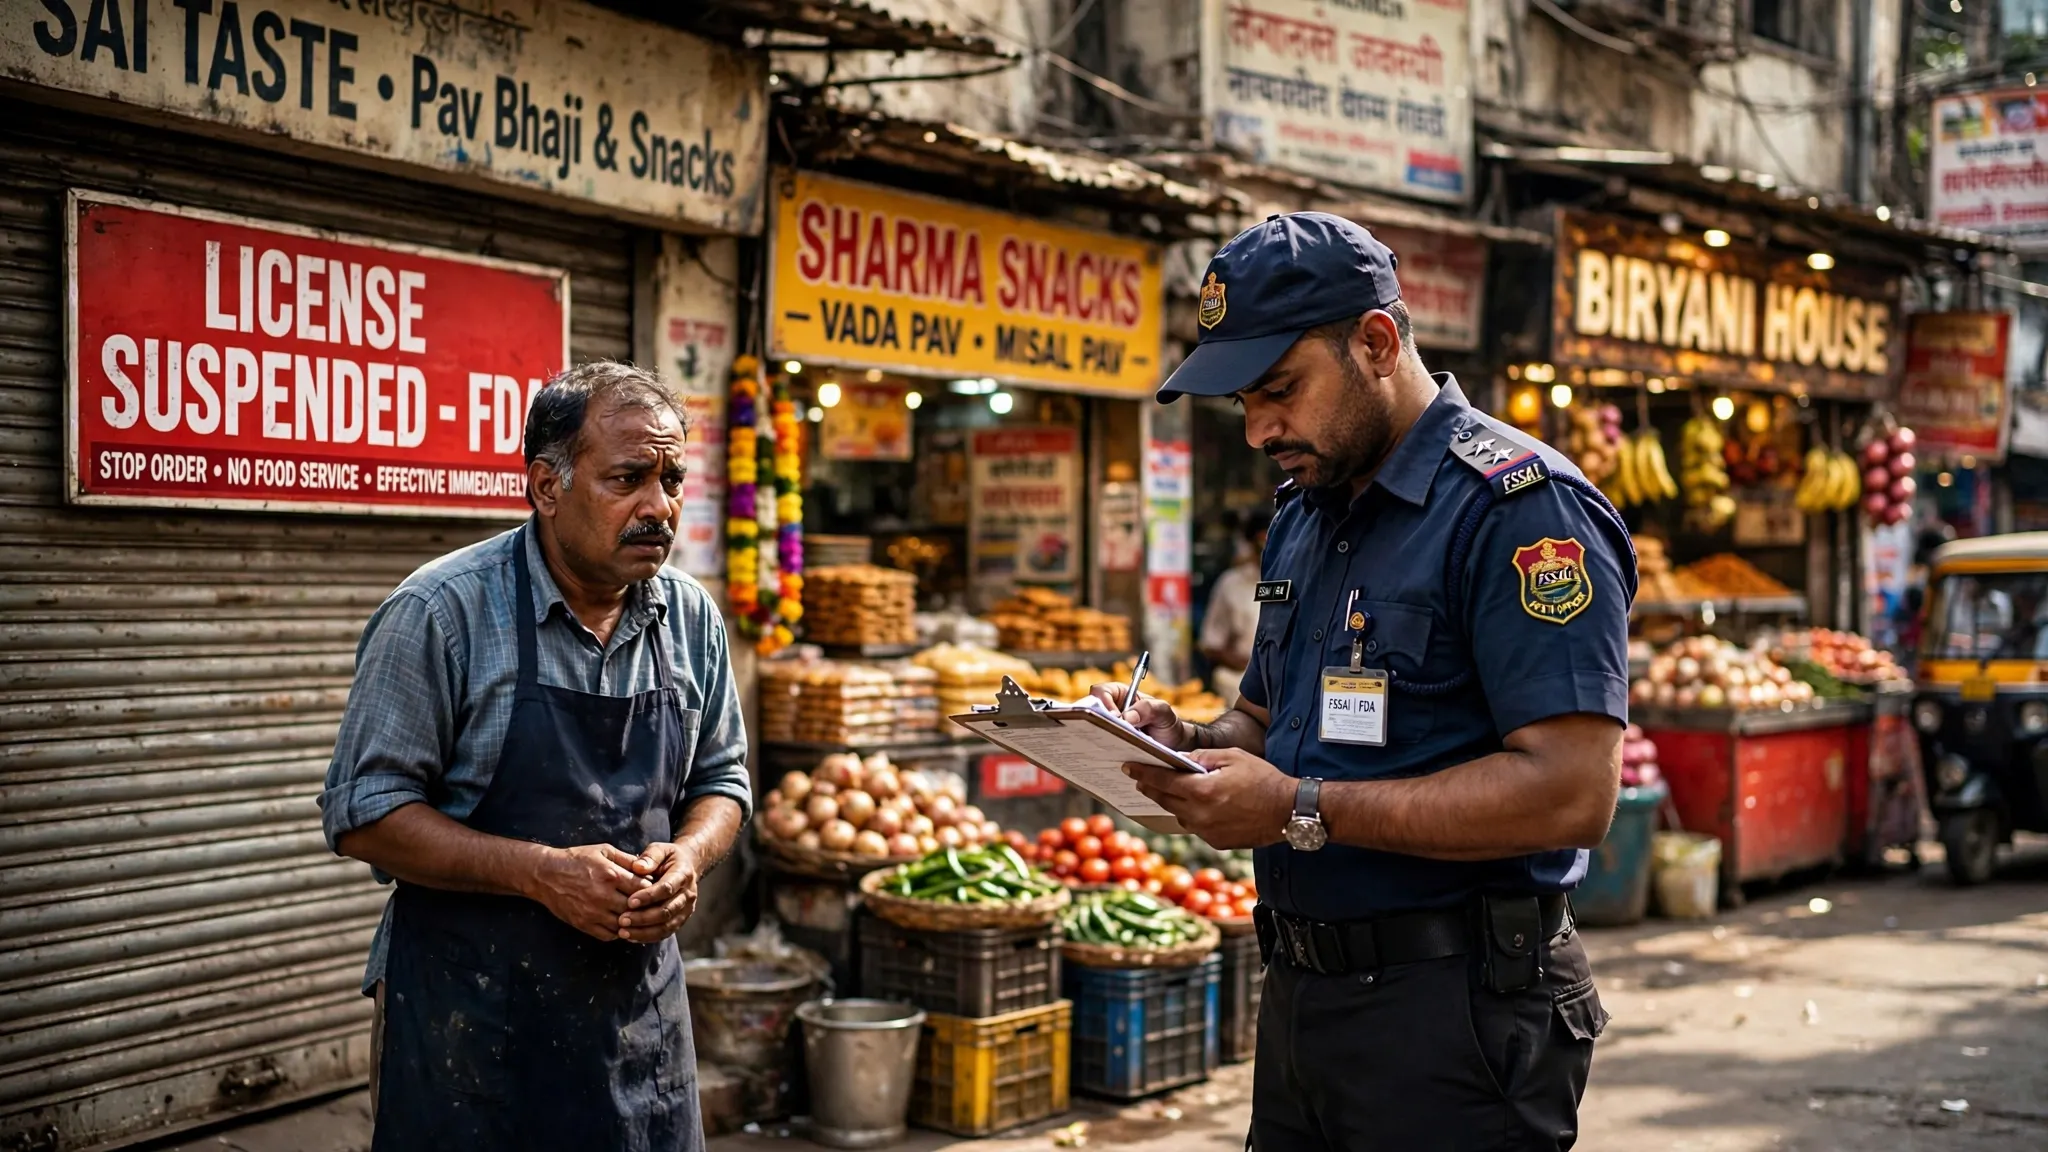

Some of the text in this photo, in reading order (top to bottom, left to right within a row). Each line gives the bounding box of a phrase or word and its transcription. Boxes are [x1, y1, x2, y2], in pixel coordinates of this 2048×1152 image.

[33, 0, 148, 73] SAI
[174, 0, 358, 121] TASTE
[411, 54, 483, 140] Pav
[495, 76, 583, 179] Bhaji
[594, 103, 618, 172] &
[630, 110, 736, 197] Snacks
[205, 240, 427, 354] LICENSE
[798, 200, 1142, 329] SHARMA SNACKS
[1576, 248, 1889, 375] BIRYANI HOUSE
[101, 334, 426, 447] SUSPENDED
[820, 299, 901, 349] VADA
[910, 311, 963, 355] PAV
[995, 323, 1072, 370] MISAL
[1080, 334, 1127, 375] PAV
[100, 451, 146, 480] STOP
[151, 455, 207, 484] ORDER
[227, 458, 250, 486] NO
[255, 459, 296, 488] FOOD
[300, 461, 359, 491] SERVICE
[377, 467, 446, 494] EFFECTIVE
[1502, 463, 1545, 492] FSSAI
[1328, 698, 1351, 711] FSSAI
[1359, 700, 1376, 713] FDA
